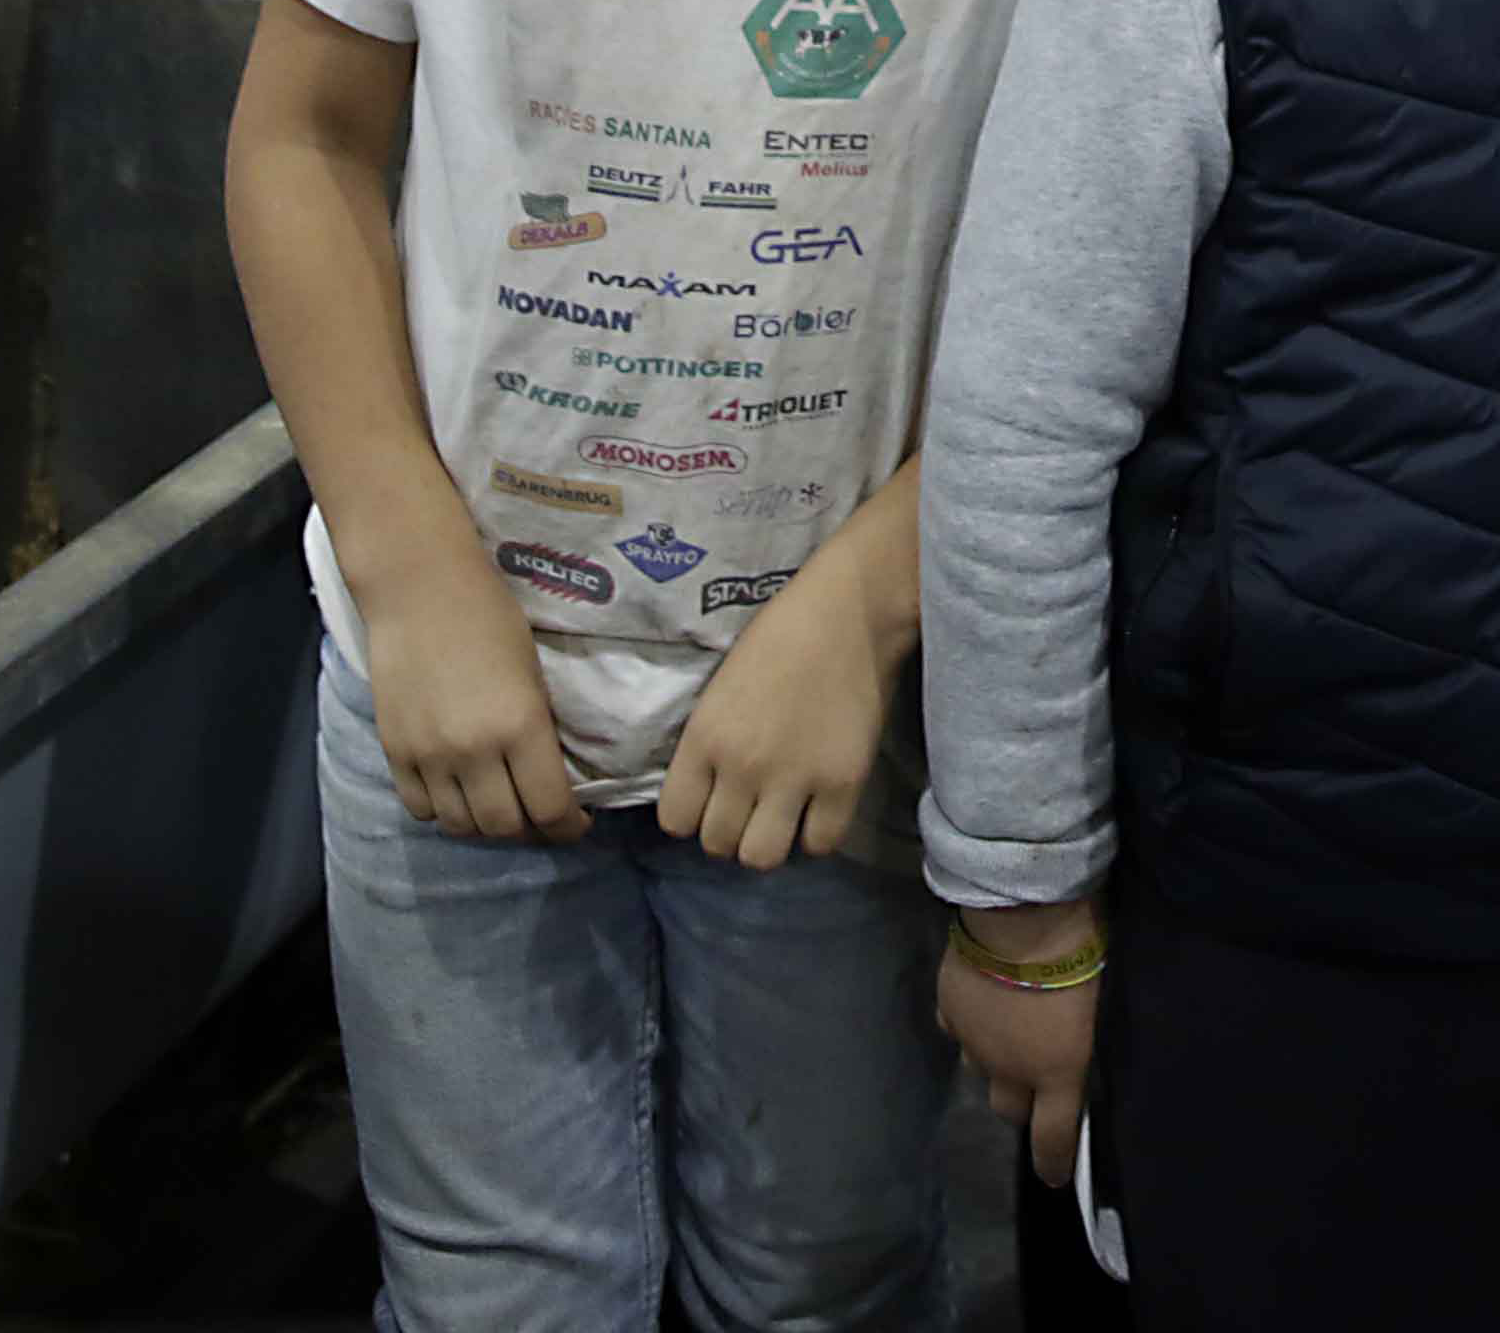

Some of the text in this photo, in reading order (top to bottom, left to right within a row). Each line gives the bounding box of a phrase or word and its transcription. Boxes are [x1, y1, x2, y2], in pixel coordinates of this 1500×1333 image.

[604, 117, 711, 149] SANTANA
[764, 130, 868, 150] ENTEC
[588, 164, 771, 195] DEUTZ FAHR
[750, 225, 864, 264] GEA
[587, 270, 757, 299] MAXAM
[497, 284, 633, 333] NOVADAN
[733, 306, 857, 338] Barbier
[528, 385, 642, 419] KRONE
[588, 442, 736, 471] MONOSEM
[513, 553, 600, 591] KOLTEC
